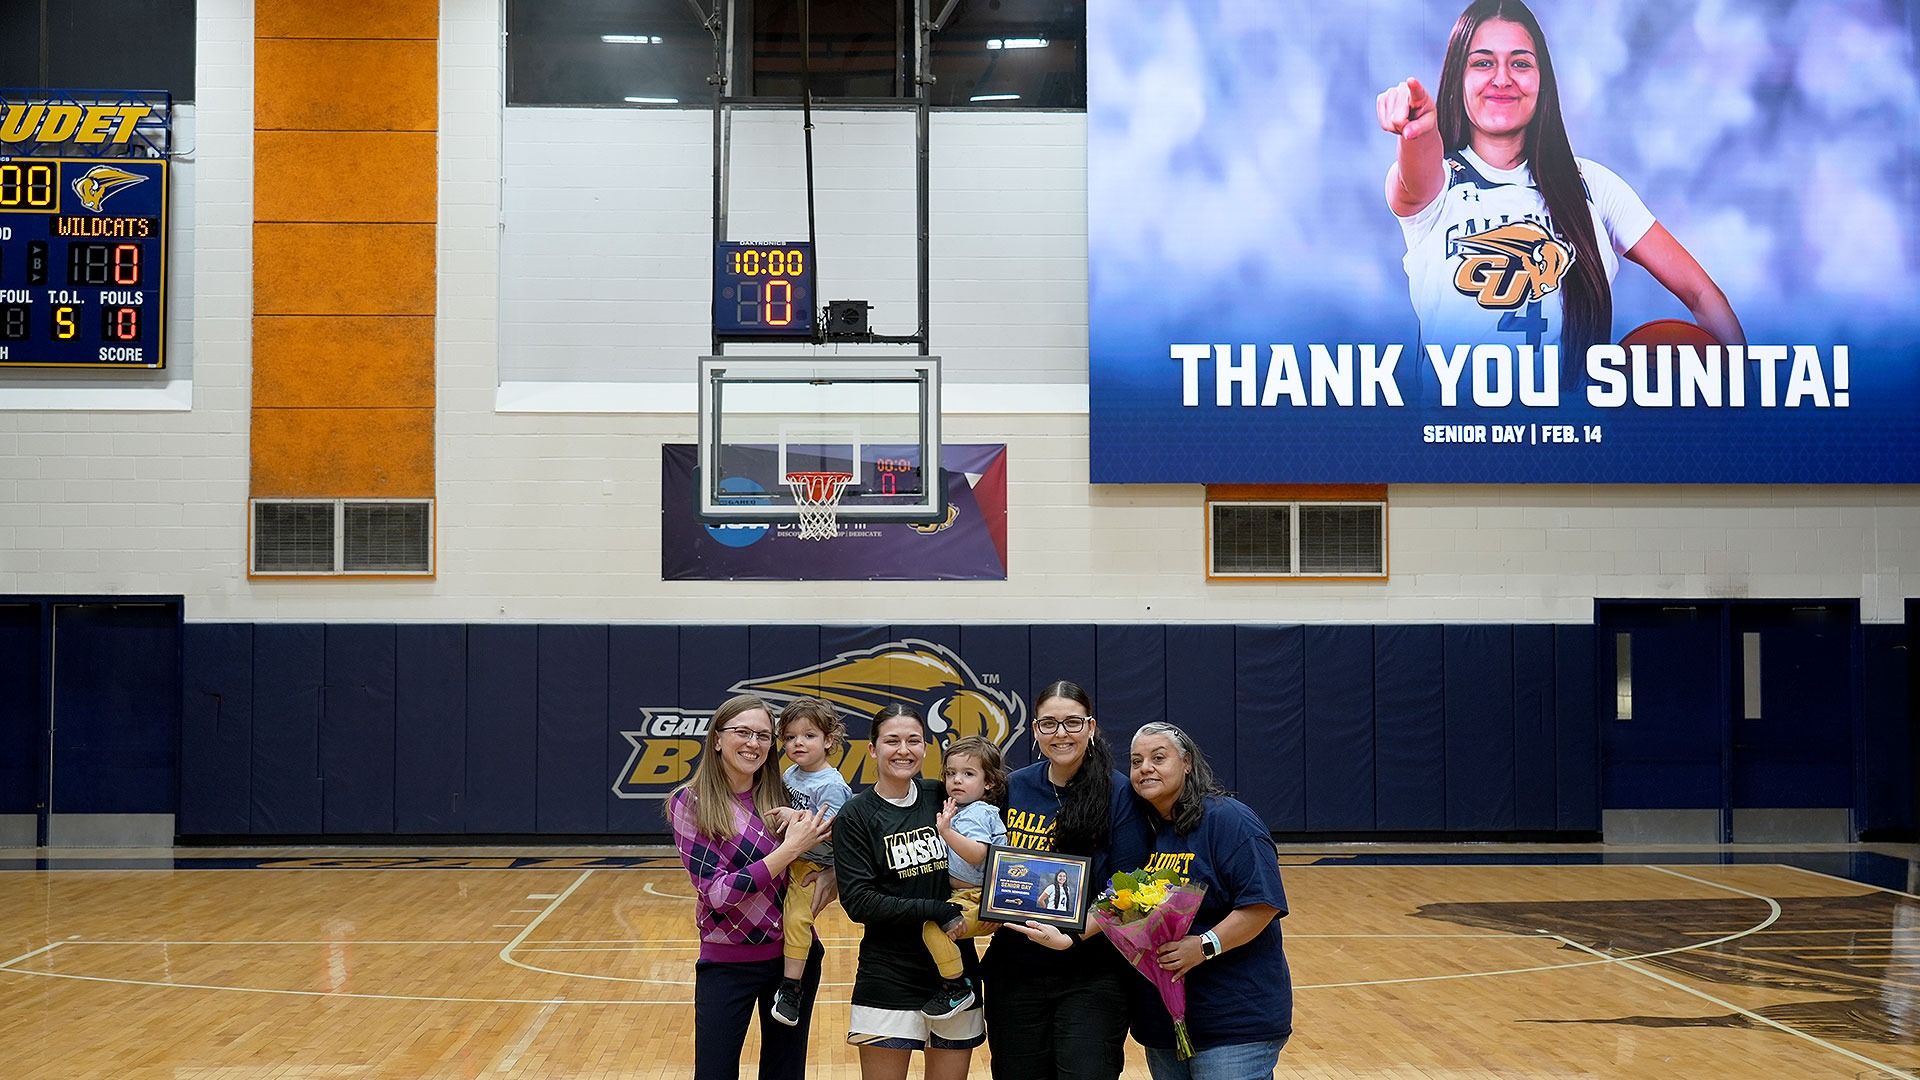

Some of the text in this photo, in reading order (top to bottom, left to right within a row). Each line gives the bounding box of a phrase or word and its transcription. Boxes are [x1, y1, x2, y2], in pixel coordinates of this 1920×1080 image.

[58, 217, 149, 237] WILDCATS
[735, 249, 803, 276] 10:00
[0, 289, 34, 304] FOUL
[48, 290, 85, 305] T.O.L.
[100, 290, 144, 305] FOULS
[56, 307, 75, 339] 5
[117, 308, 137, 340] 0
[99, 346, 143, 361] SCORE
[1170, 343, 1850, 408] THANK YOU SUNITA!
[1423, 424, 1487, 443] SENIOR
[1491, 424, 1527, 443] DAY
[1541, 424, 1580, 443] FEB.
[1583, 424, 1602, 443] 14
[982, 673, 1000, 684] TM
[919, 863, 933, 875] THE
